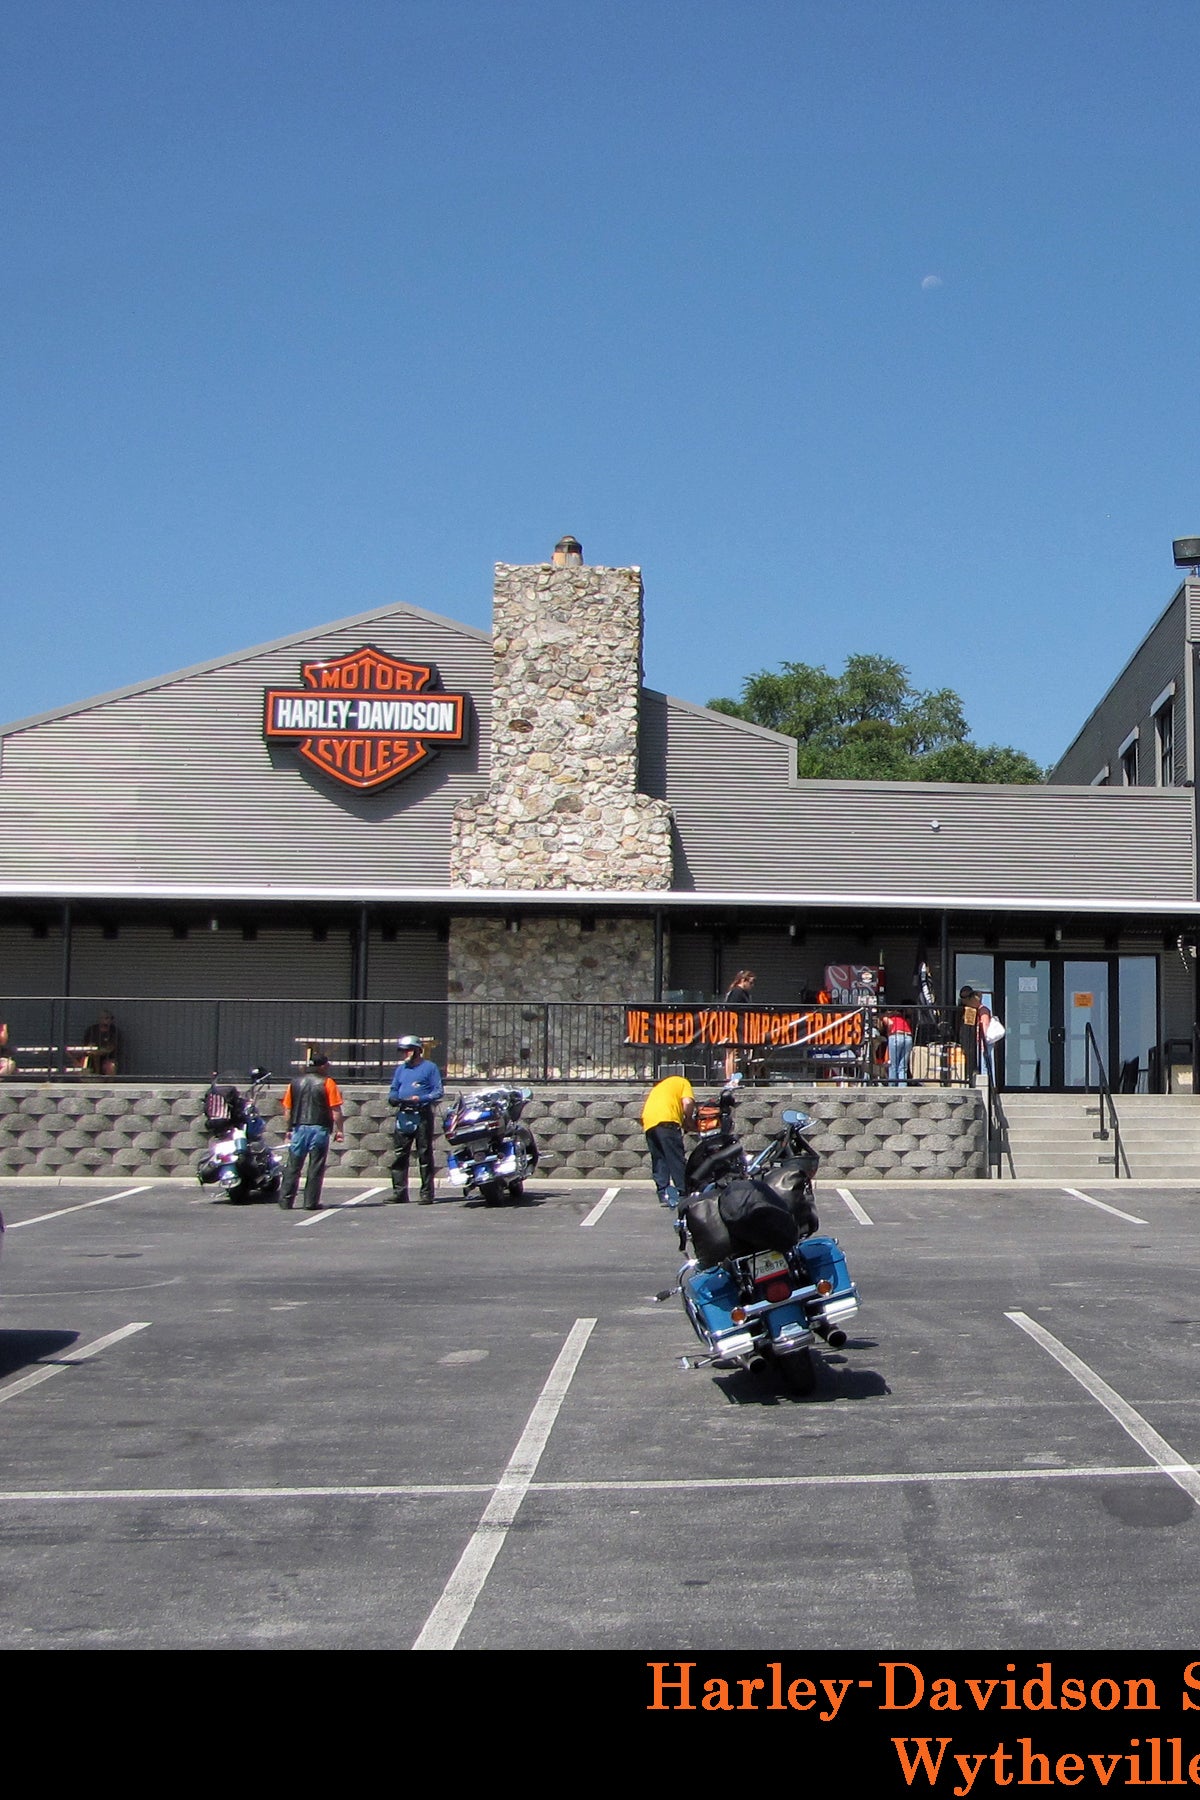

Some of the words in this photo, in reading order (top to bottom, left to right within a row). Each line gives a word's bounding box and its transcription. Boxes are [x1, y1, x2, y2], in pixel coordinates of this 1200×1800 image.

[321, 657, 414, 691] MOTOR
[277, 698, 455, 732] HARLEY-DAVIDSON
[317, 739, 409, 778] CYCLES
[628, 1011, 650, 1044] WE
[655, 1011, 694, 1044] NEED
[698, 1011, 739, 1045] YOUR
[744, 1012, 800, 1045] IMPORT
[805, 1012, 862, 1045] TRADES
